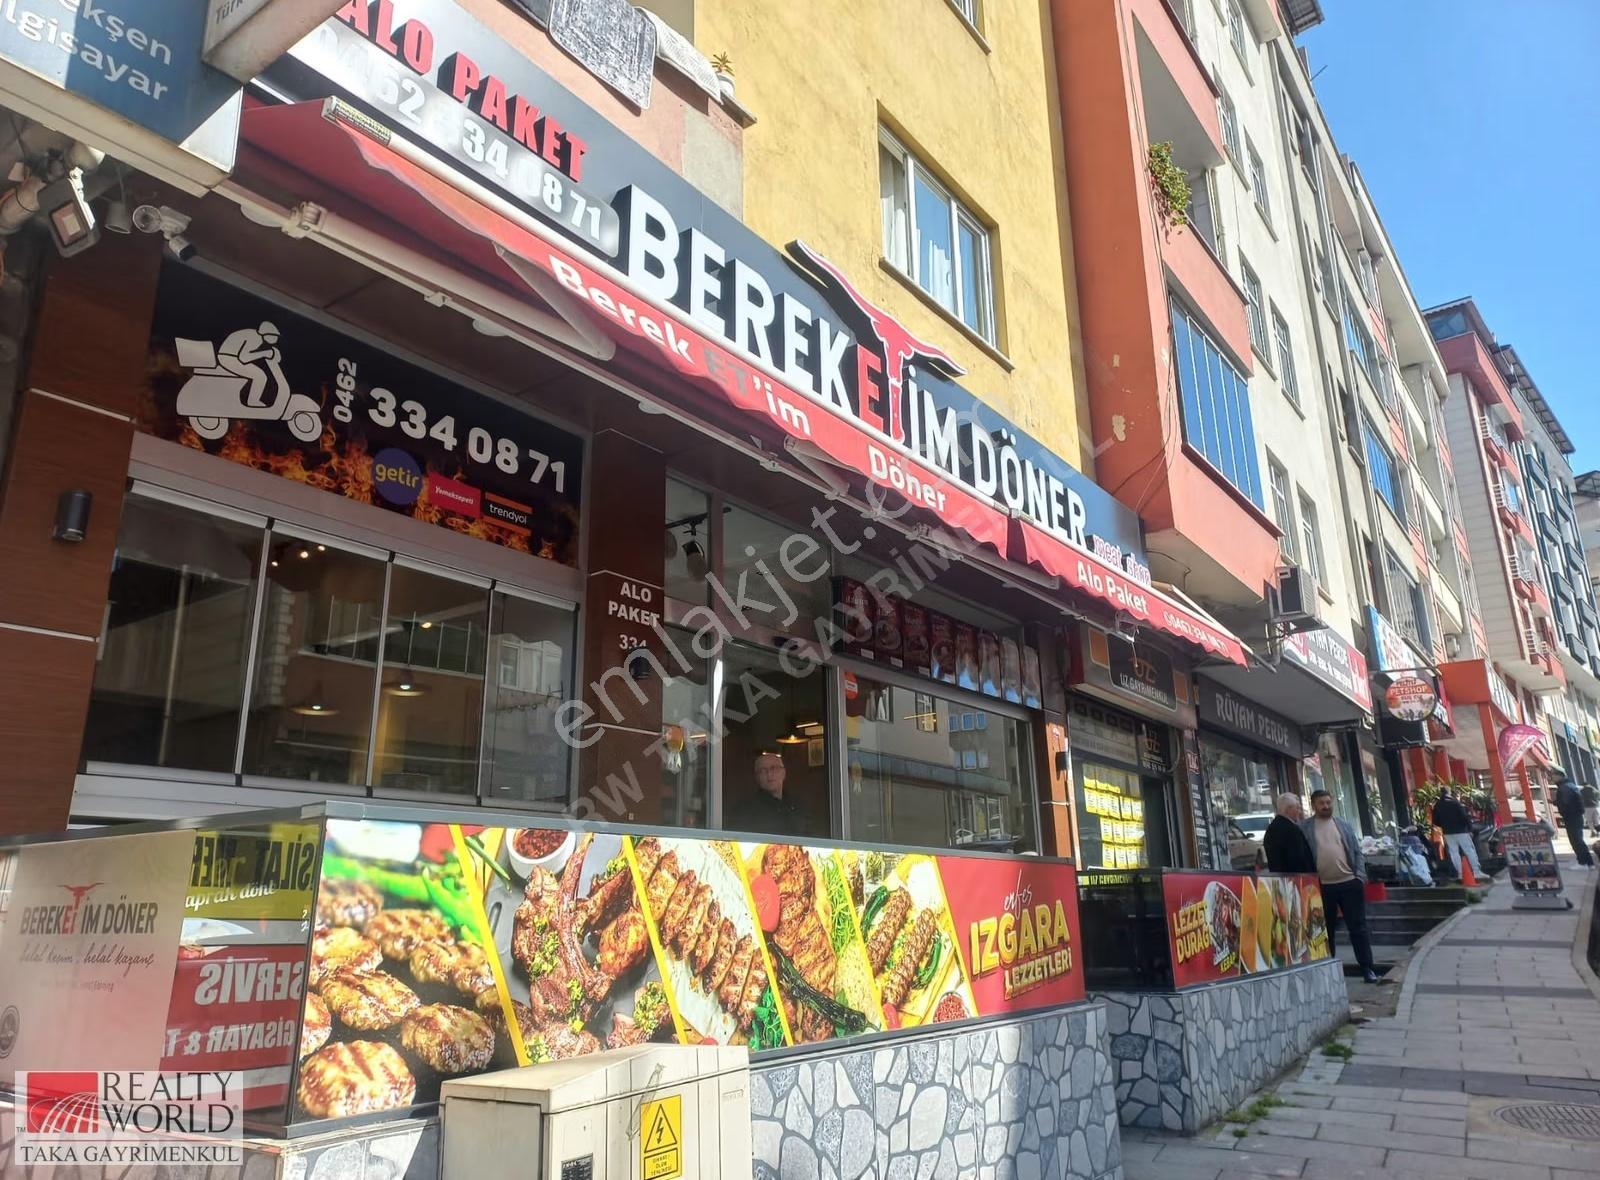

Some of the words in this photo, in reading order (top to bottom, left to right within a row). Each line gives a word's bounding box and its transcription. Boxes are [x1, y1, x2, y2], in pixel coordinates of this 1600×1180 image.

[336, 0, 434, 76] ALO
[453, 51, 588, 183] PAKET
[570, 190, 602, 241] 71
[549, 254, 696, 365] Berek
[868, 444, 947, 513] Döner
[333, 357, 357, 424] 0462
[368, 387, 458, 451] 334
[468, 427, 519, 475] 08
[528, 449, 565, 493] 71
[375, 462, 420, 489] getir
[969, 421, 1087, 547] DÖNER
[489, 503, 527, 525] trendyol
[608, 600, 660, 628] PAKET
[620, 582, 652, 603] ALO
[1077, 560, 1104, 593] Alo
[1106, 574, 1150, 616] Paket
[1215, 688, 1255, 733] RÜYAM
[1258, 713, 1289, 748] PERDE
[102, 894, 159, 935] DÖNER
[970, 899, 1070, 976] IZGARA
[84, 942, 111, 964] helal
[1004, 946, 1072, 1000] LEZZETLERİ
